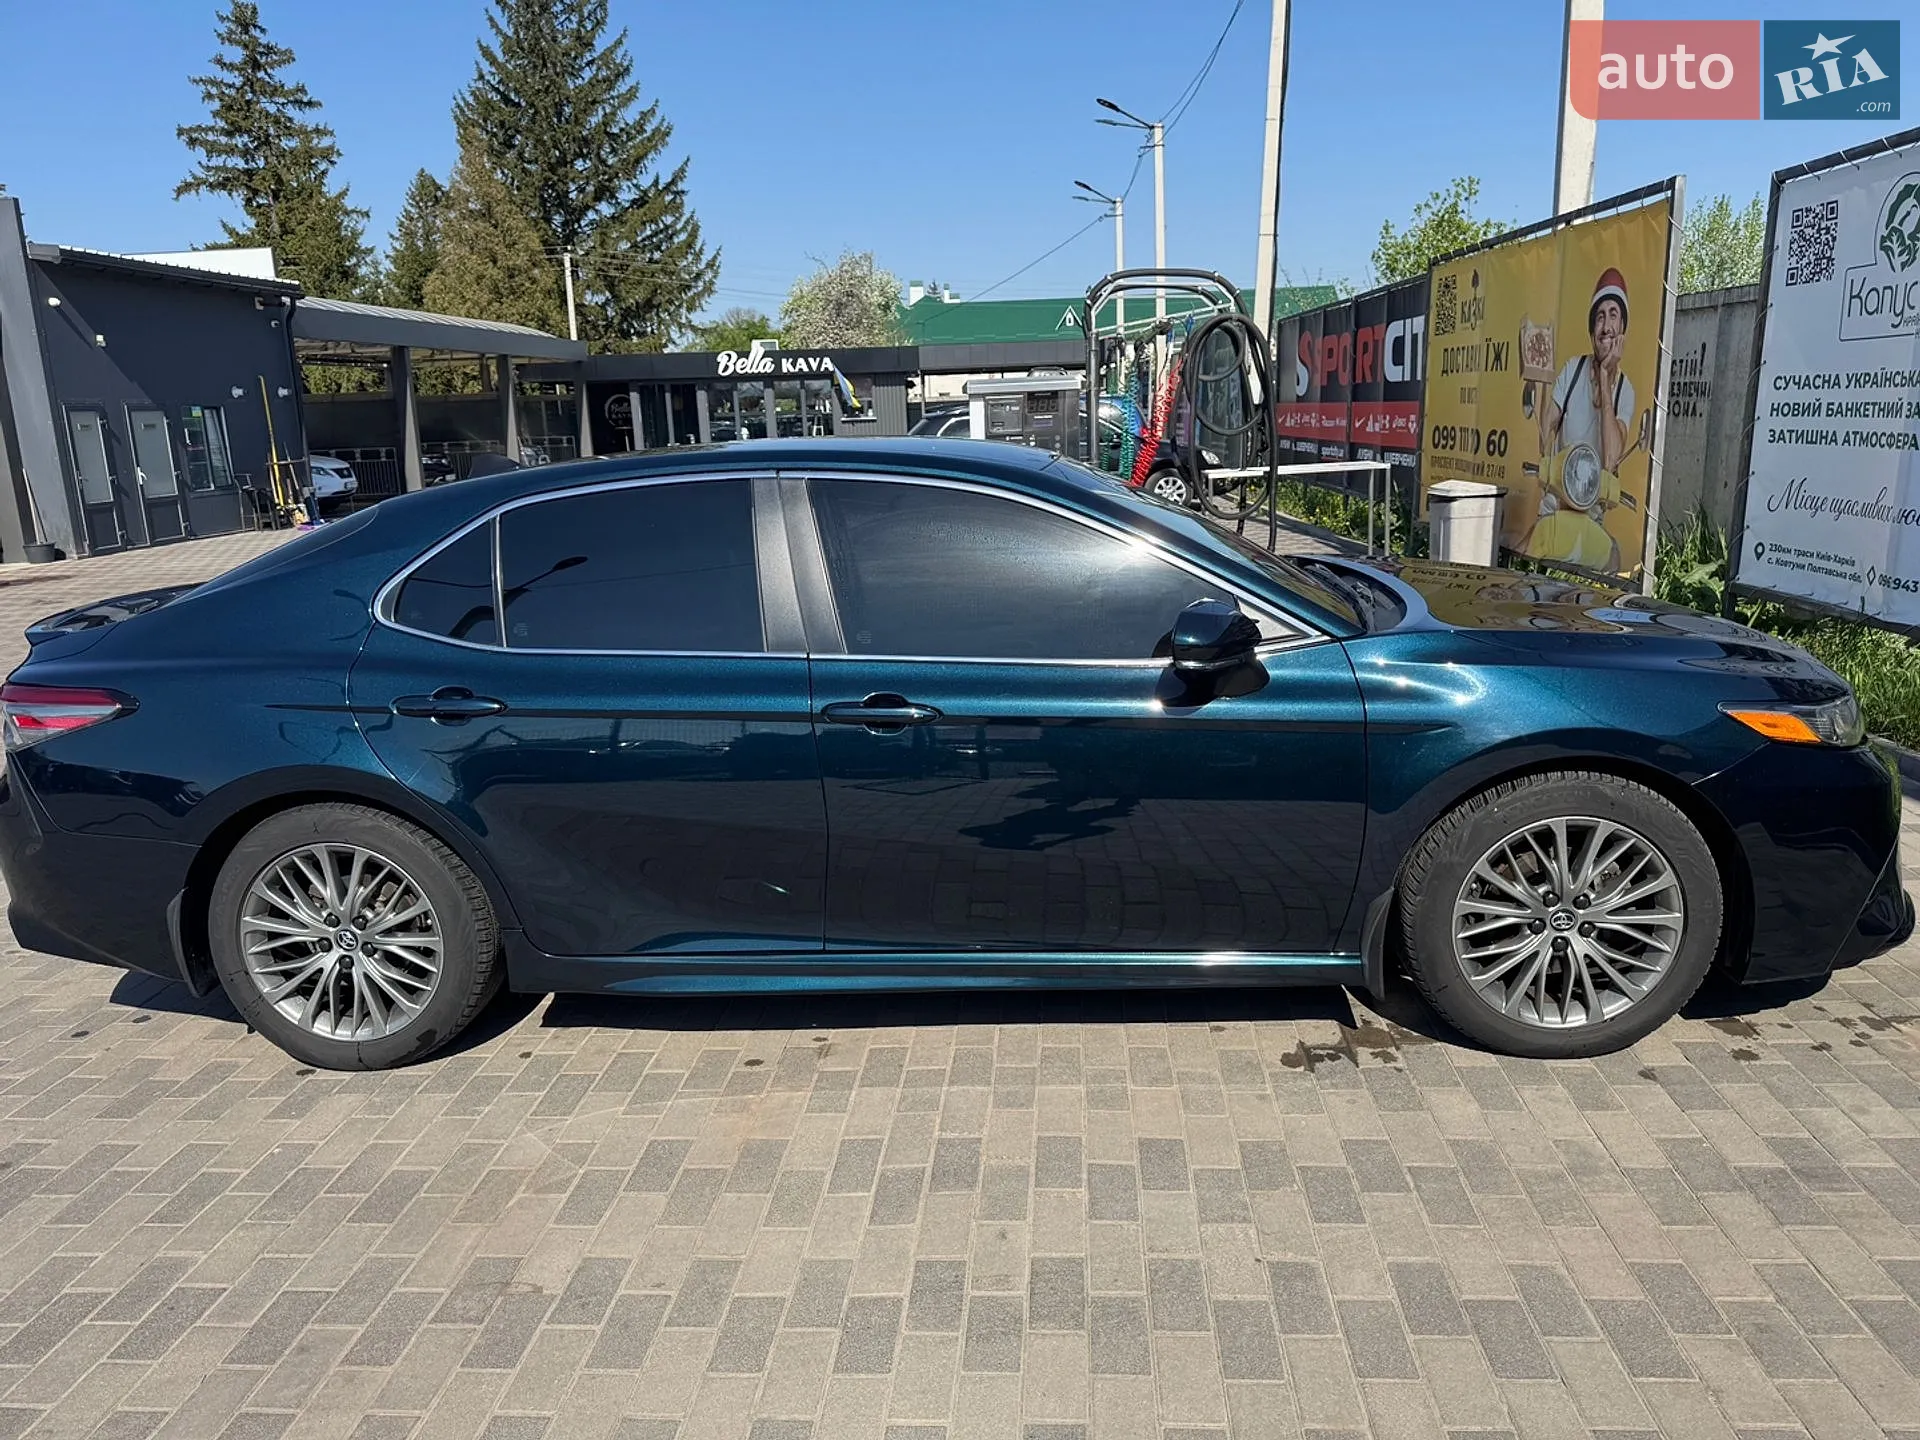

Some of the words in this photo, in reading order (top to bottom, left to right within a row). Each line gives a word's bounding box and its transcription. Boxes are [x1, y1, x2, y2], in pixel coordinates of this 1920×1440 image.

[716, 343, 775, 376] Bella
[781, 357, 834, 374] KAVA
[1484, 338, 1510, 372] ЇЖІ
[1773, 373, 1841, 391] СУЧАСНА
[1845, 367, 1920, 389] УКРАЇНСЬКА
[1769, 397, 1822, 418] НОВИЙ
[1825, 397, 1903, 419] БАНКЕТНИЙ
[1432, 425, 1456, 451] 099
[1486, 429, 1508, 458] 60
[1767, 429, 1839, 446] ЗАТИШНА
[1842, 430, 1920, 451] АТМОСФЕРА
[1767, 477, 1829, 519] Місце
[1768, 543, 1793, 555] 230км
[1793, 547, 1815, 559] траси
[1892, 577, 1919, 593] 943
